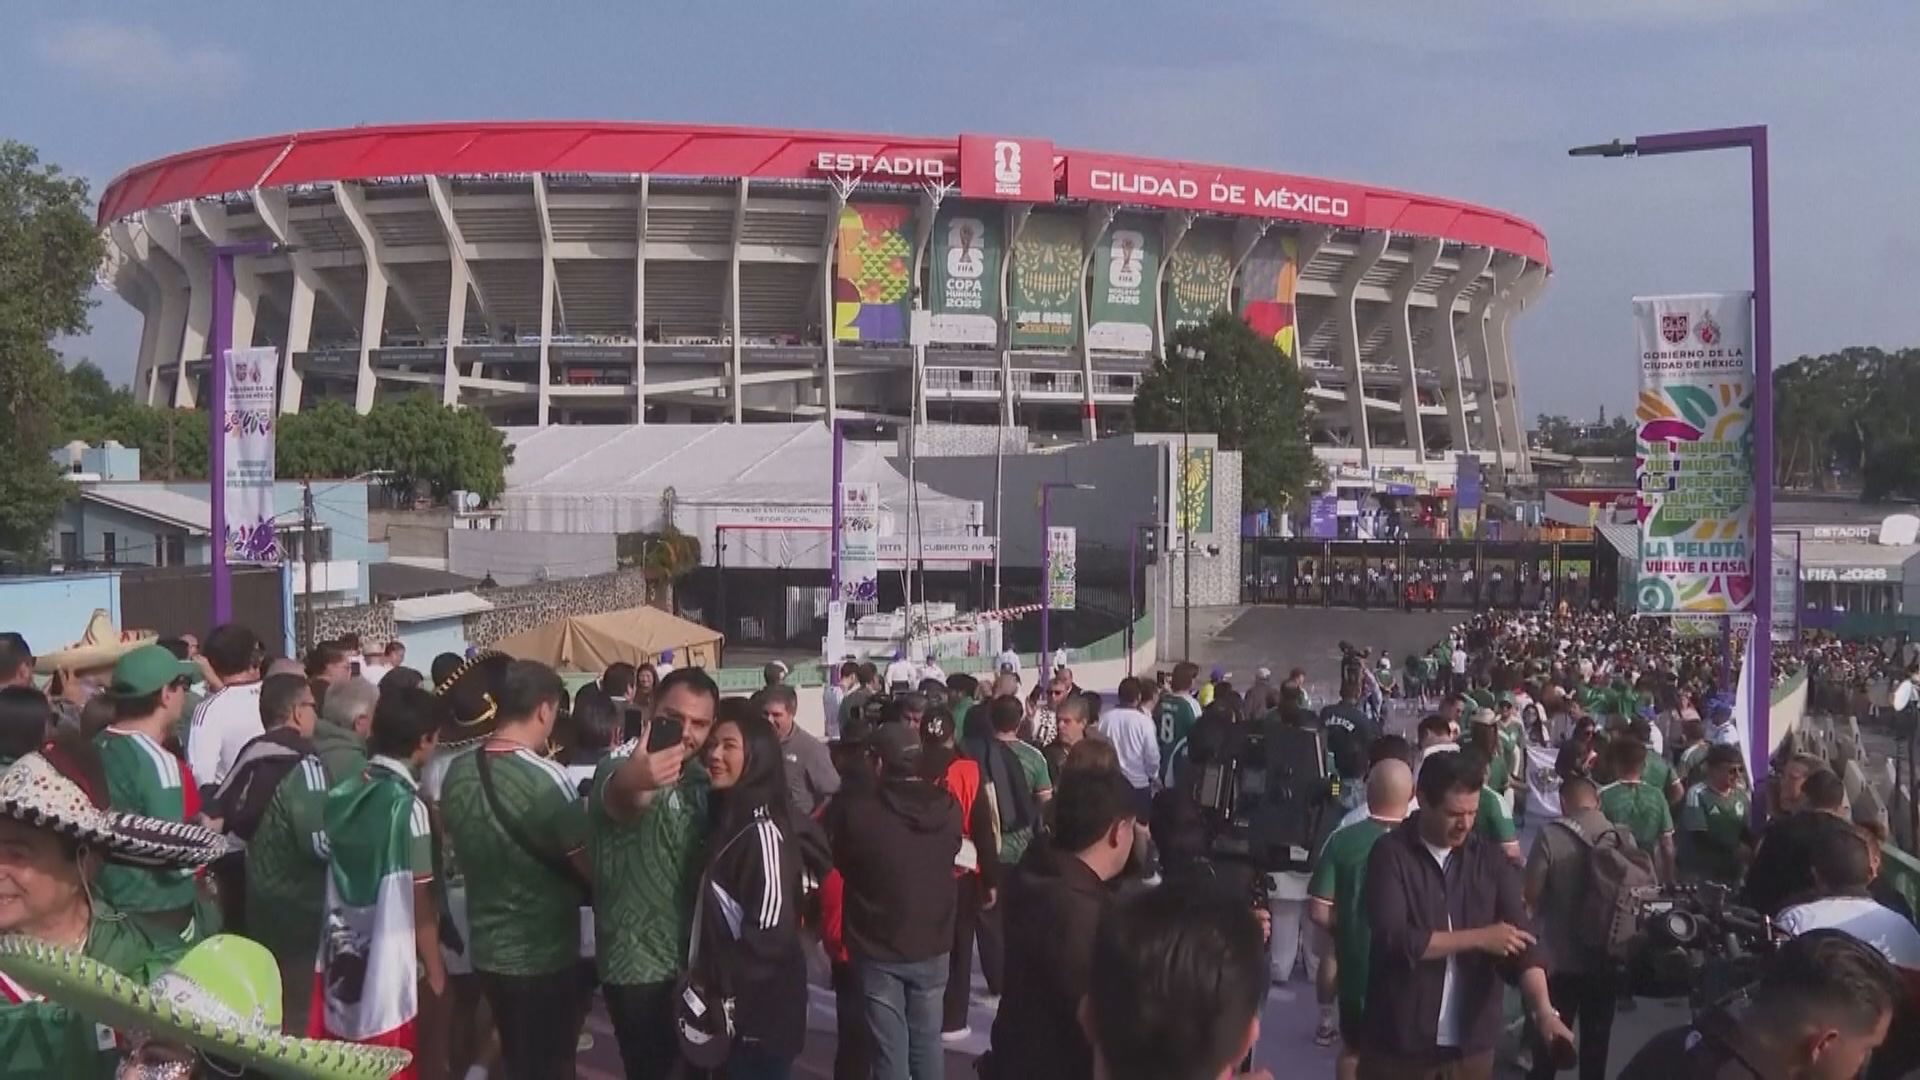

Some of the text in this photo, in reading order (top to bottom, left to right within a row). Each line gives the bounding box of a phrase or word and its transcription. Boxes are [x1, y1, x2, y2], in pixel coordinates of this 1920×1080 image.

[817, 152, 943, 176] ESTADIO
[1090, 170, 1348, 217] CIUDAD DE MÉXICO
[946, 279, 982, 291] COPA
[1643, 348, 1743, 360] GOBIERNO DE LA
[1643, 358, 1744, 370] CIUDAD DE MÉXICO
[1646, 459, 1673, 471] QUE
[1681, 458, 1730, 471] MUEVE
[1642, 475, 1752, 490] LAS PERSONAS
[1662, 507, 1729, 520] DEPORTE
[1814, 527, 1870, 538] ESTADIO
[923, 543, 968, 552] CUBIERTO
[1645, 542, 1745, 557] LA PELOTA
[1646, 561, 1747, 573] VUELVE A CASA
[1807, 568, 1837, 581] FIFA
[1839, 568, 1887, 580] 2026
[1160, 713, 1175, 744] 8
